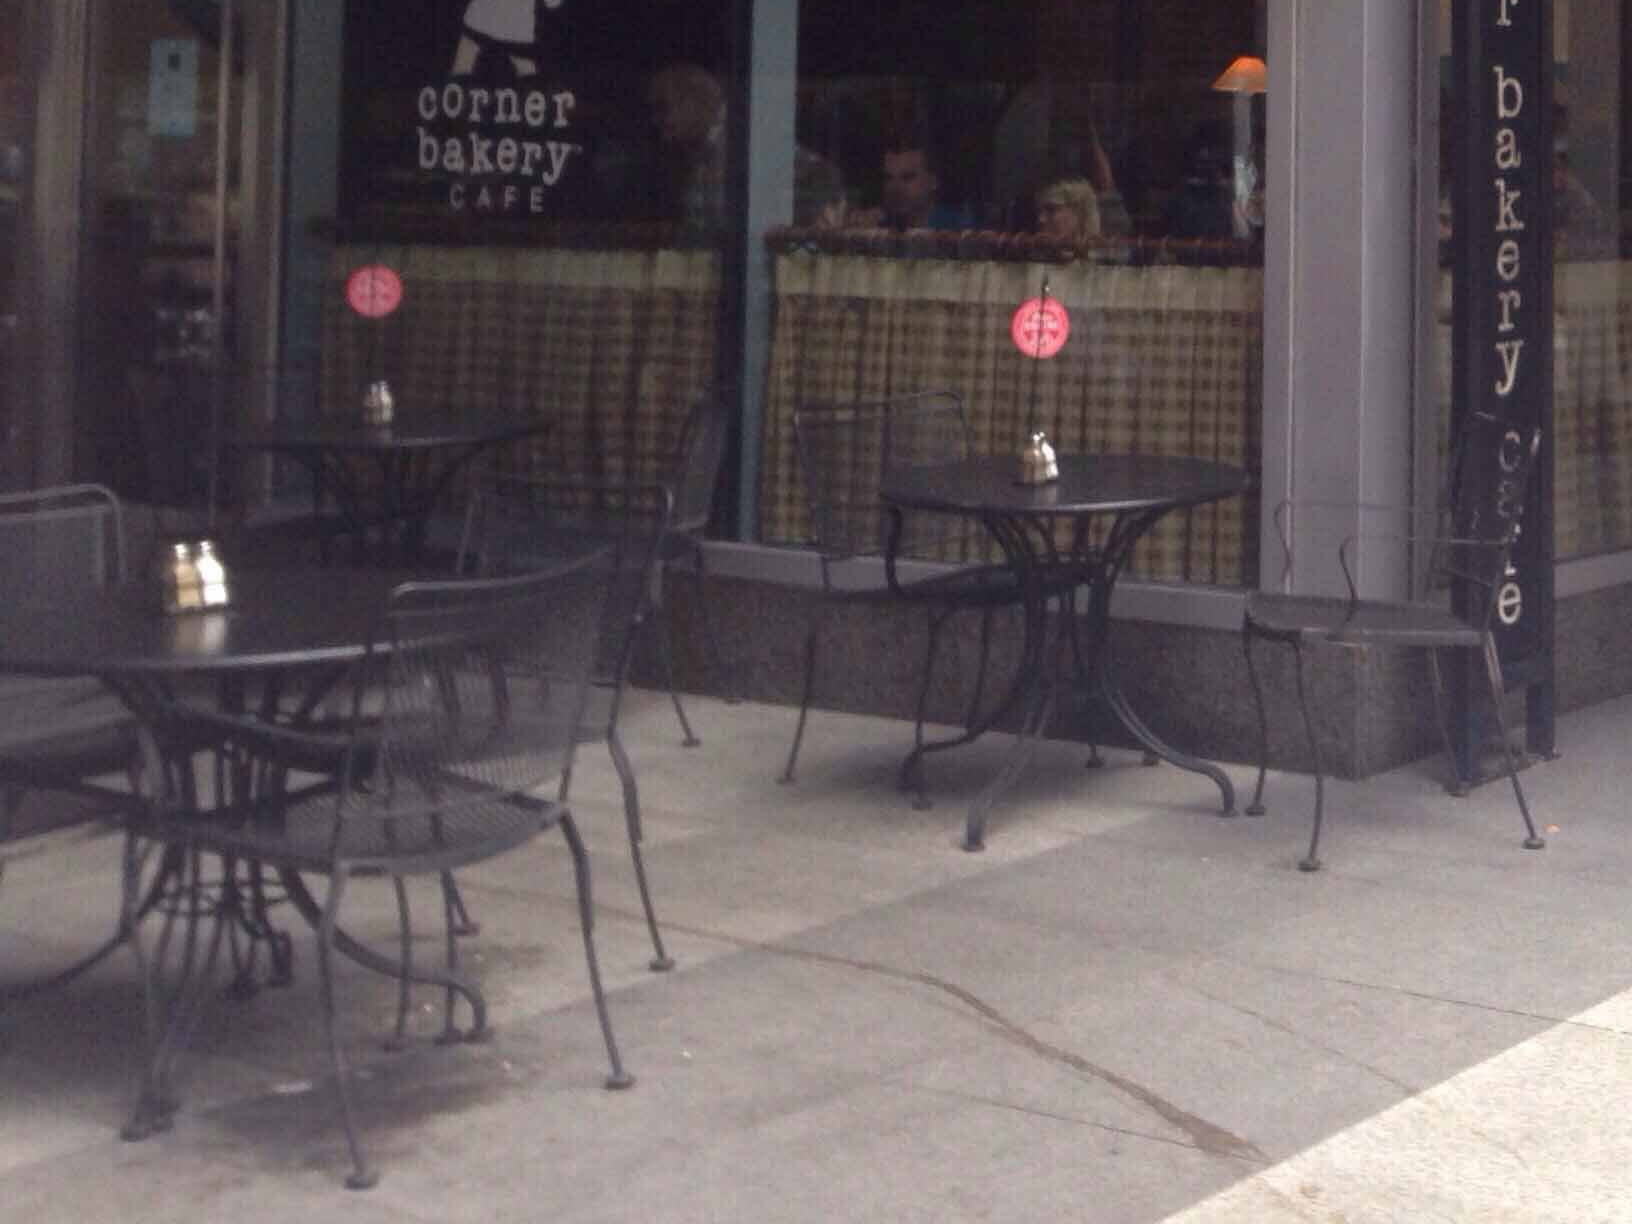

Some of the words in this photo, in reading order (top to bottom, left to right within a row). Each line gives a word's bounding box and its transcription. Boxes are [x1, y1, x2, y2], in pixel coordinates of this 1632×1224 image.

[418, 83, 576, 127] corner
[417, 127, 573, 185] bakery
[450, 185, 545, 213] CAFE
[1494, 66, 1525, 396] bakery
